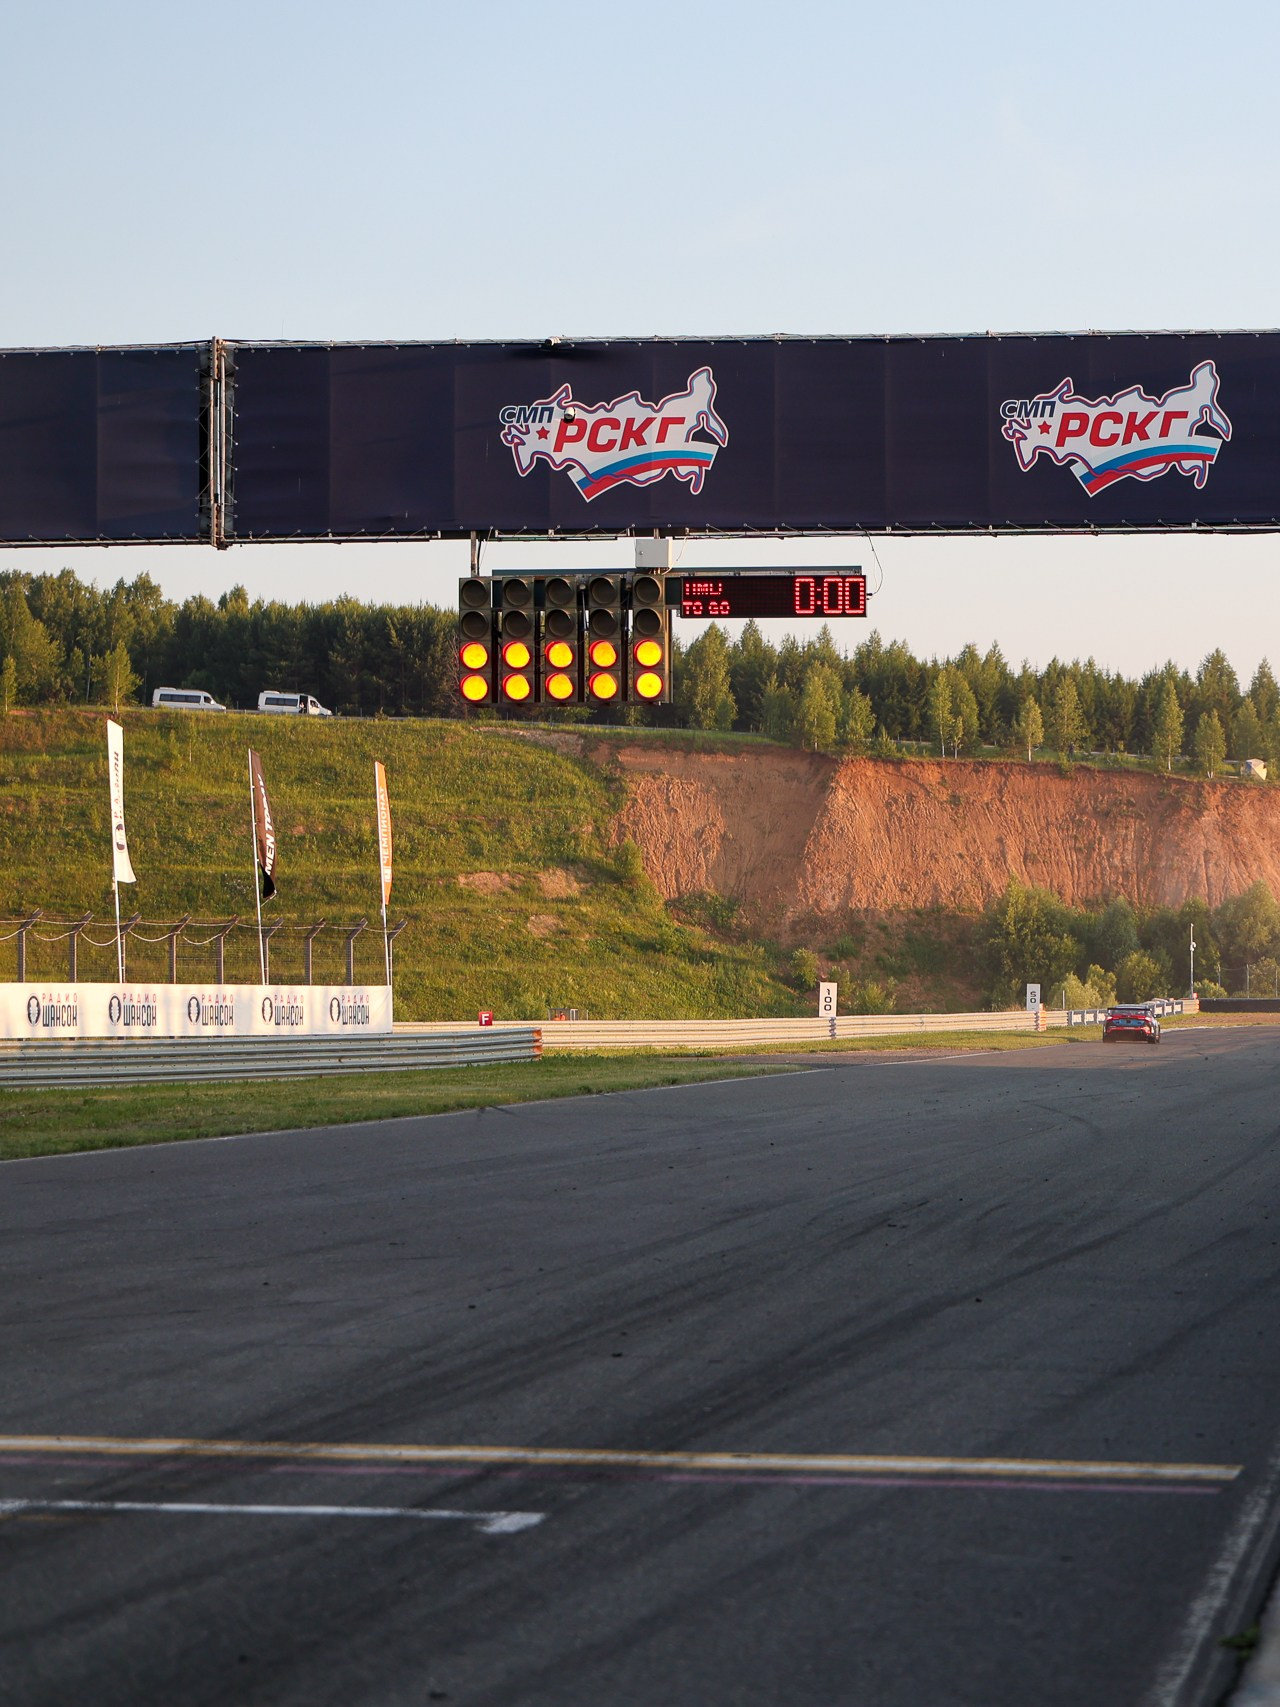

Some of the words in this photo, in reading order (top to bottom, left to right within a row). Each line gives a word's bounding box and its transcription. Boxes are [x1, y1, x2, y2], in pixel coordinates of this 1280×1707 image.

[500, 406, 555, 424] СМП
[1001, 400, 1056, 418] СМП
[553, 416, 686, 452] РСКГ
[1055, 410, 1189, 447] РСКГ
[794, 578, 865, 614] 0:00
[380, 787, 390, 864] ЧЕМПИОНАТ
[265, 834, 275, 876] MEN
[42, 993, 78, 1002] РАДИО
[122, 993, 157, 1002] РАДИО
[201, 994, 234, 1003] РАДИО
[274, 994, 304, 1003] РАДИО
[341, 994, 370, 1003] РАДИО
[42, 1004, 78, 1027] ШАНСОН
[122, 1004, 157, 1026] ШАНСОН
[201, 1005, 234, 1026] ШАНСОН
[274, 1005, 304, 1026] ШАНСОН
[341, 1005, 370, 1025] ШАНСОН
[481, 1013, 490, 1025] F
